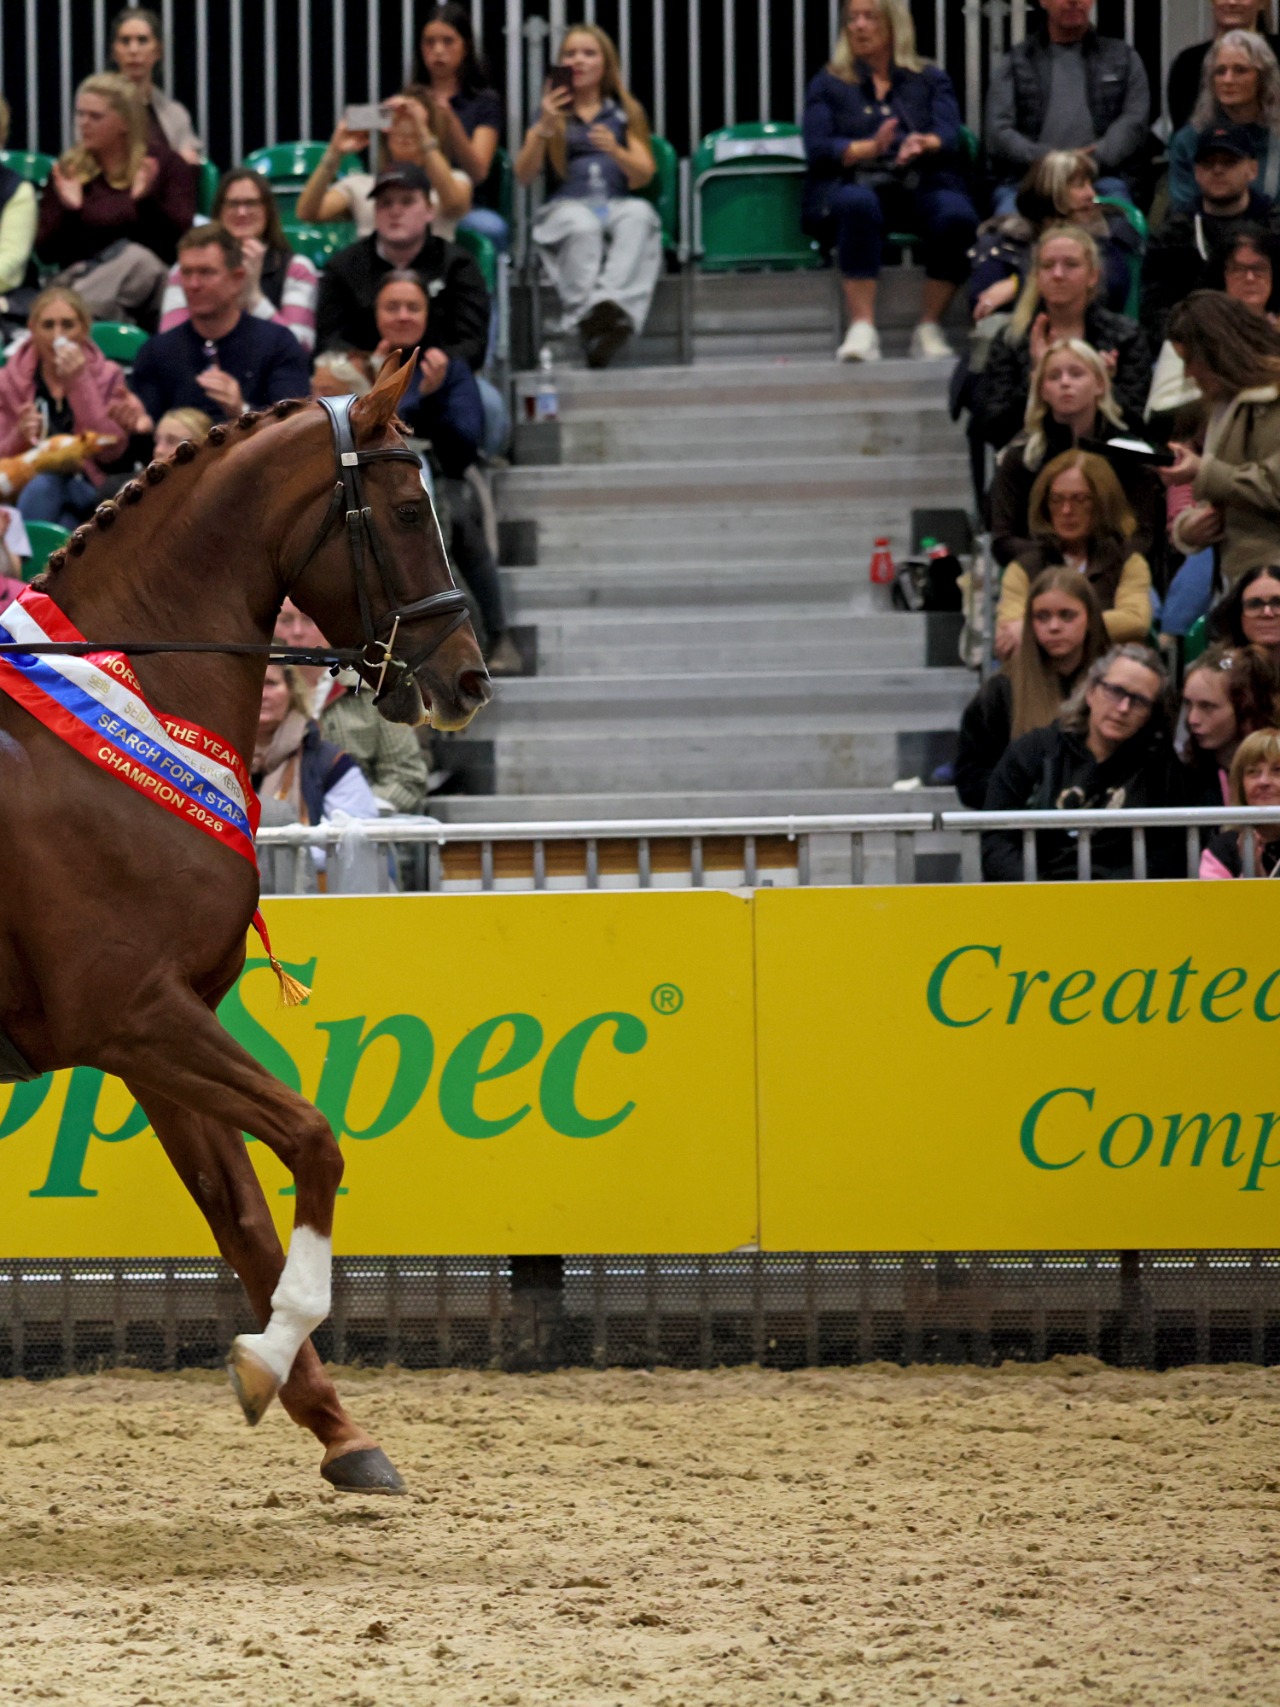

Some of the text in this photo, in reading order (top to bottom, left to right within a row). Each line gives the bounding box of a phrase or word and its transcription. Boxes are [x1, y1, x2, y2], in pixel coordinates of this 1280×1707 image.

[102, 655, 241, 770] HORS THE YEAR
[123, 701, 149, 725] SEIB
[98, 713, 161, 763] SEARCH
[160, 757, 195, 787] FOR
[192, 783, 205, 797] A
[205, 791, 243, 823] STAR
[98, 747, 224, 832] CHAMPION 2026
